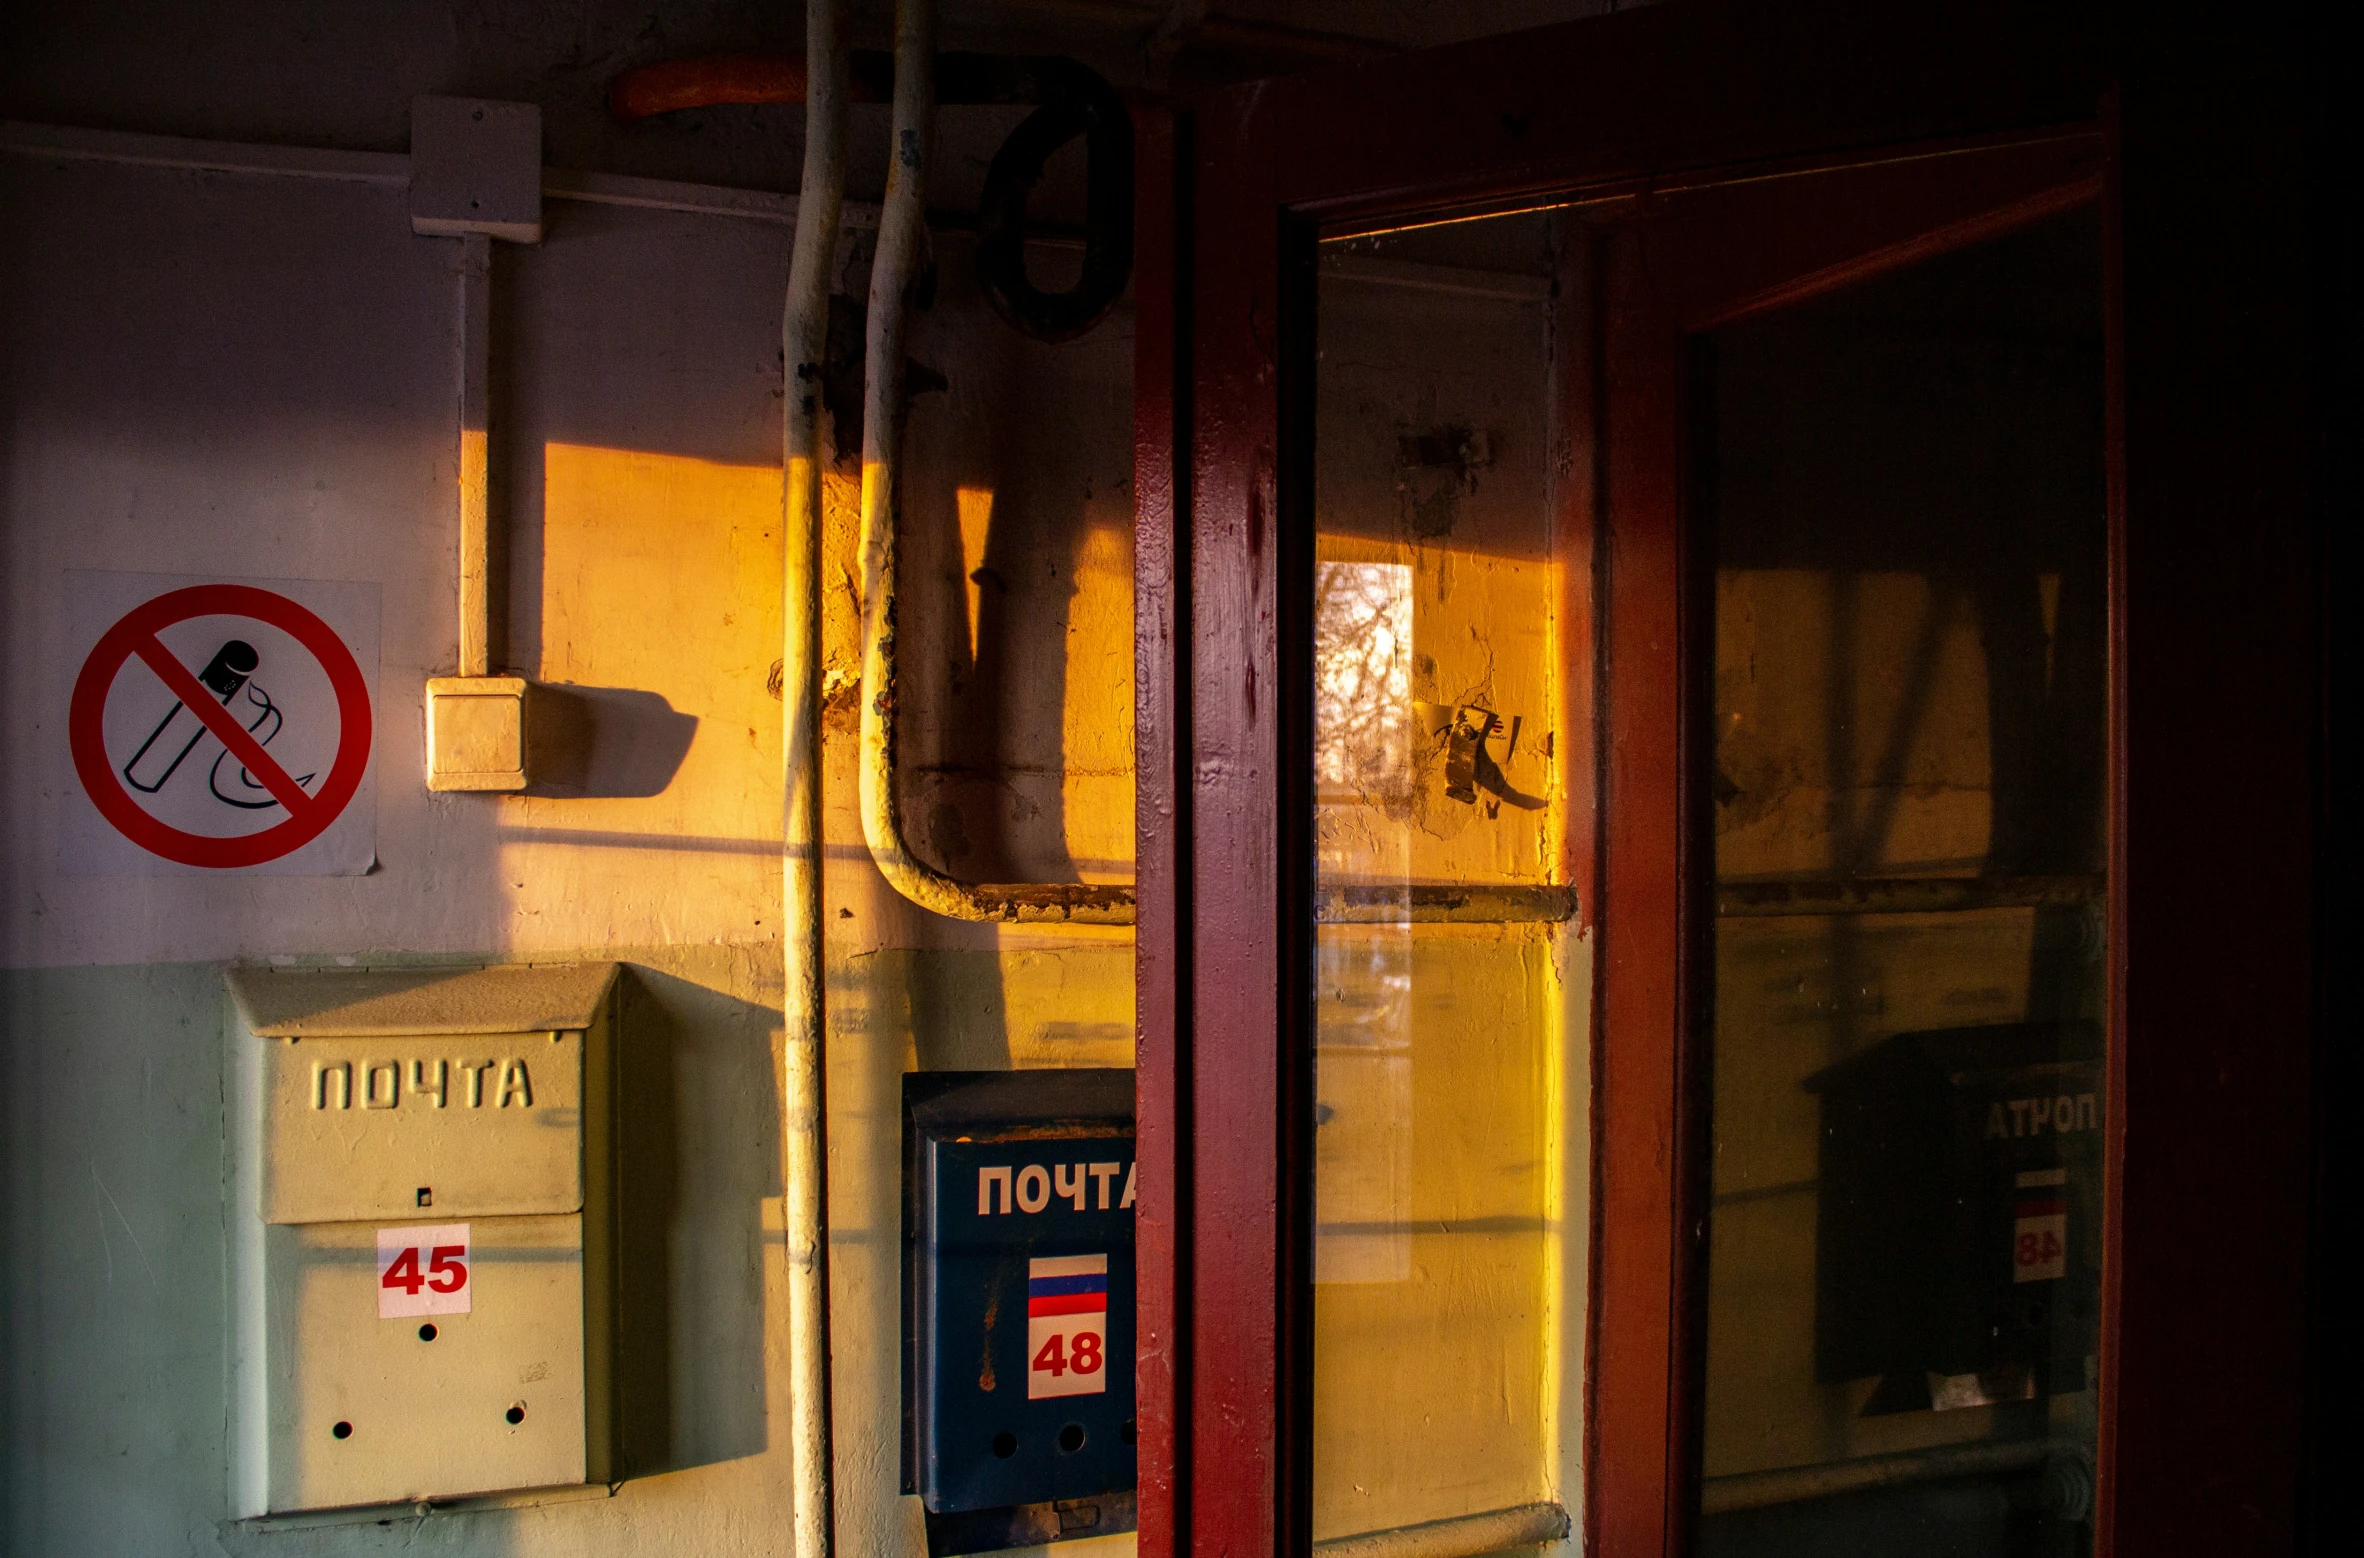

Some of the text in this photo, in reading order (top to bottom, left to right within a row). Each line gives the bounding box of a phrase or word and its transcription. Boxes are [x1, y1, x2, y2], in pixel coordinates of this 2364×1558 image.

[312, 1059, 533, 1108] ПОЧТА
[383, 1245, 467, 1295] 45
[1033, 1332, 1102, 1376] 48
